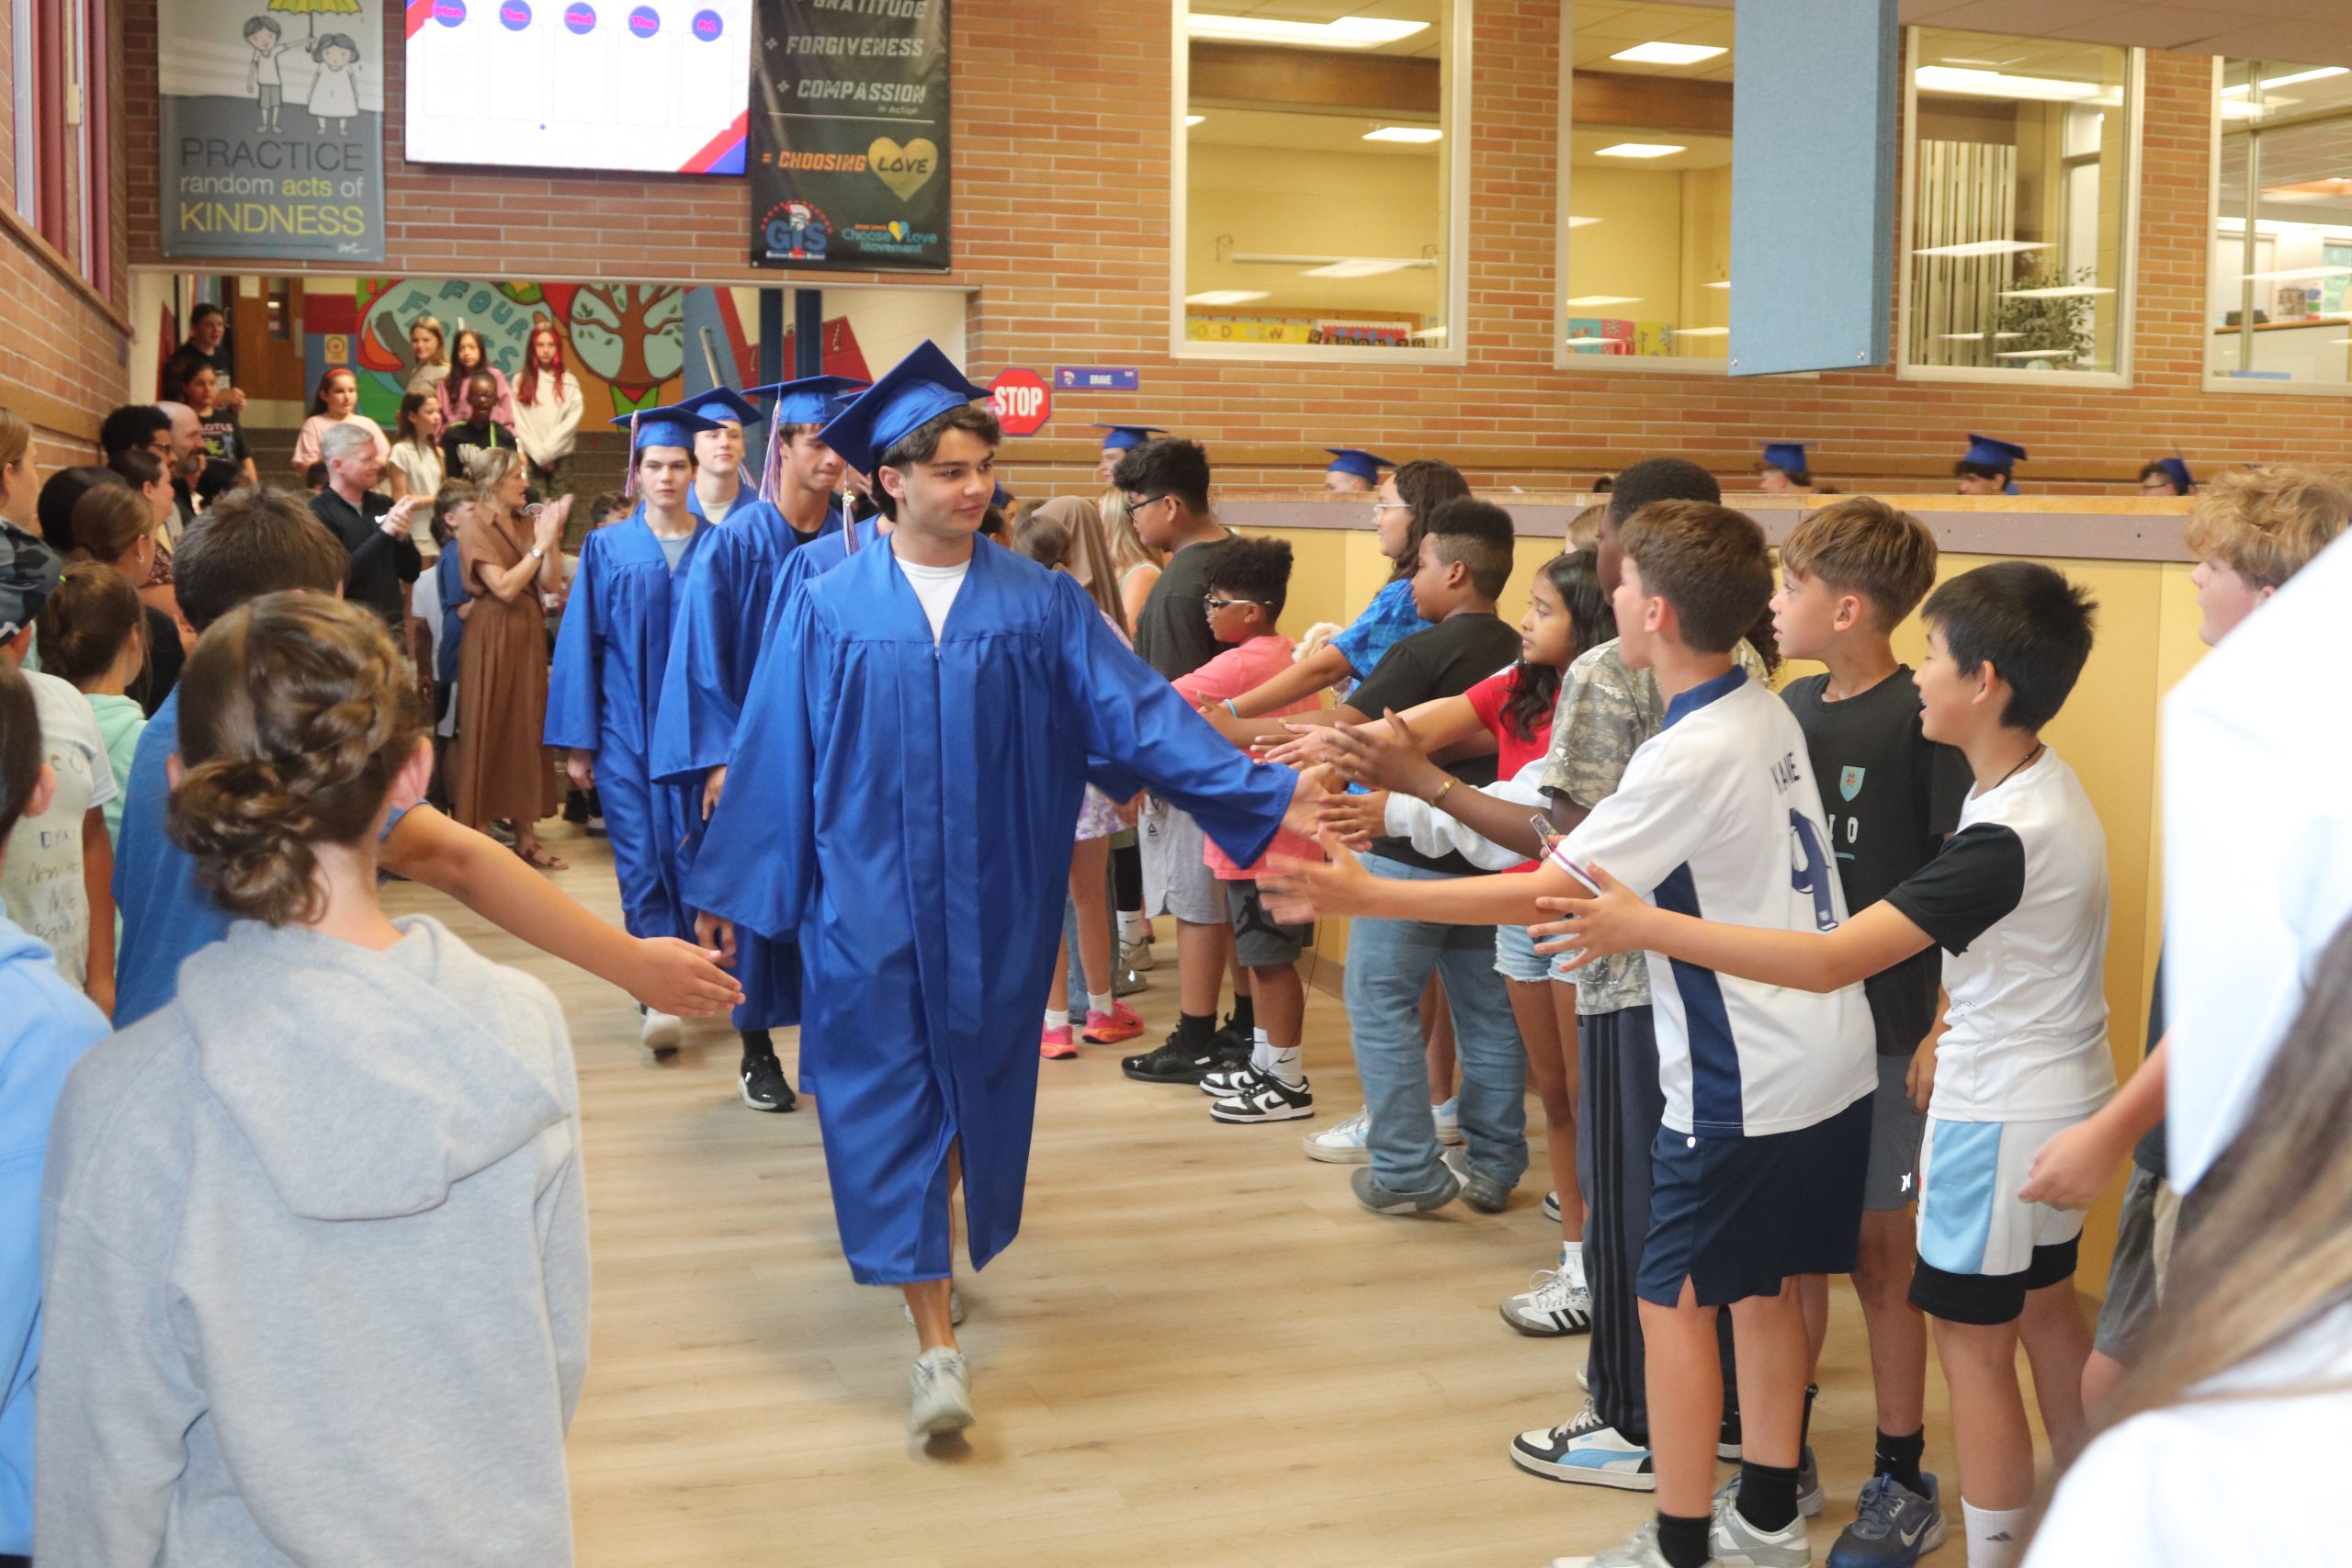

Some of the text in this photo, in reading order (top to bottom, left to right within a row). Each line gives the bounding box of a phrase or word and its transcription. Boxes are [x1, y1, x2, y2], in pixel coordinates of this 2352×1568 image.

[435, 5, 717, 32] Mon. Tue. Wed. Thu. Fri.
[786, 35, 925, 56] FORGIVENESS
[797, 79, 927, 103] COMPASSION
[888, 105, 919, 115] Action
[180, 138, 365, 173] PRACTICE
[777, 151, 868, 173] CHOOSING
[876, 156, 929, 175] LOVE
[180, 173, 366, 198] random acts of
[180, 201, 366, 236] KINDNESS
[842, 228, 938, 243] Choose Love
[859, 241, 922, 254] Movement
[438, 279, 529, 342] FOUR
[994, 386, 1043, 417] STOP
